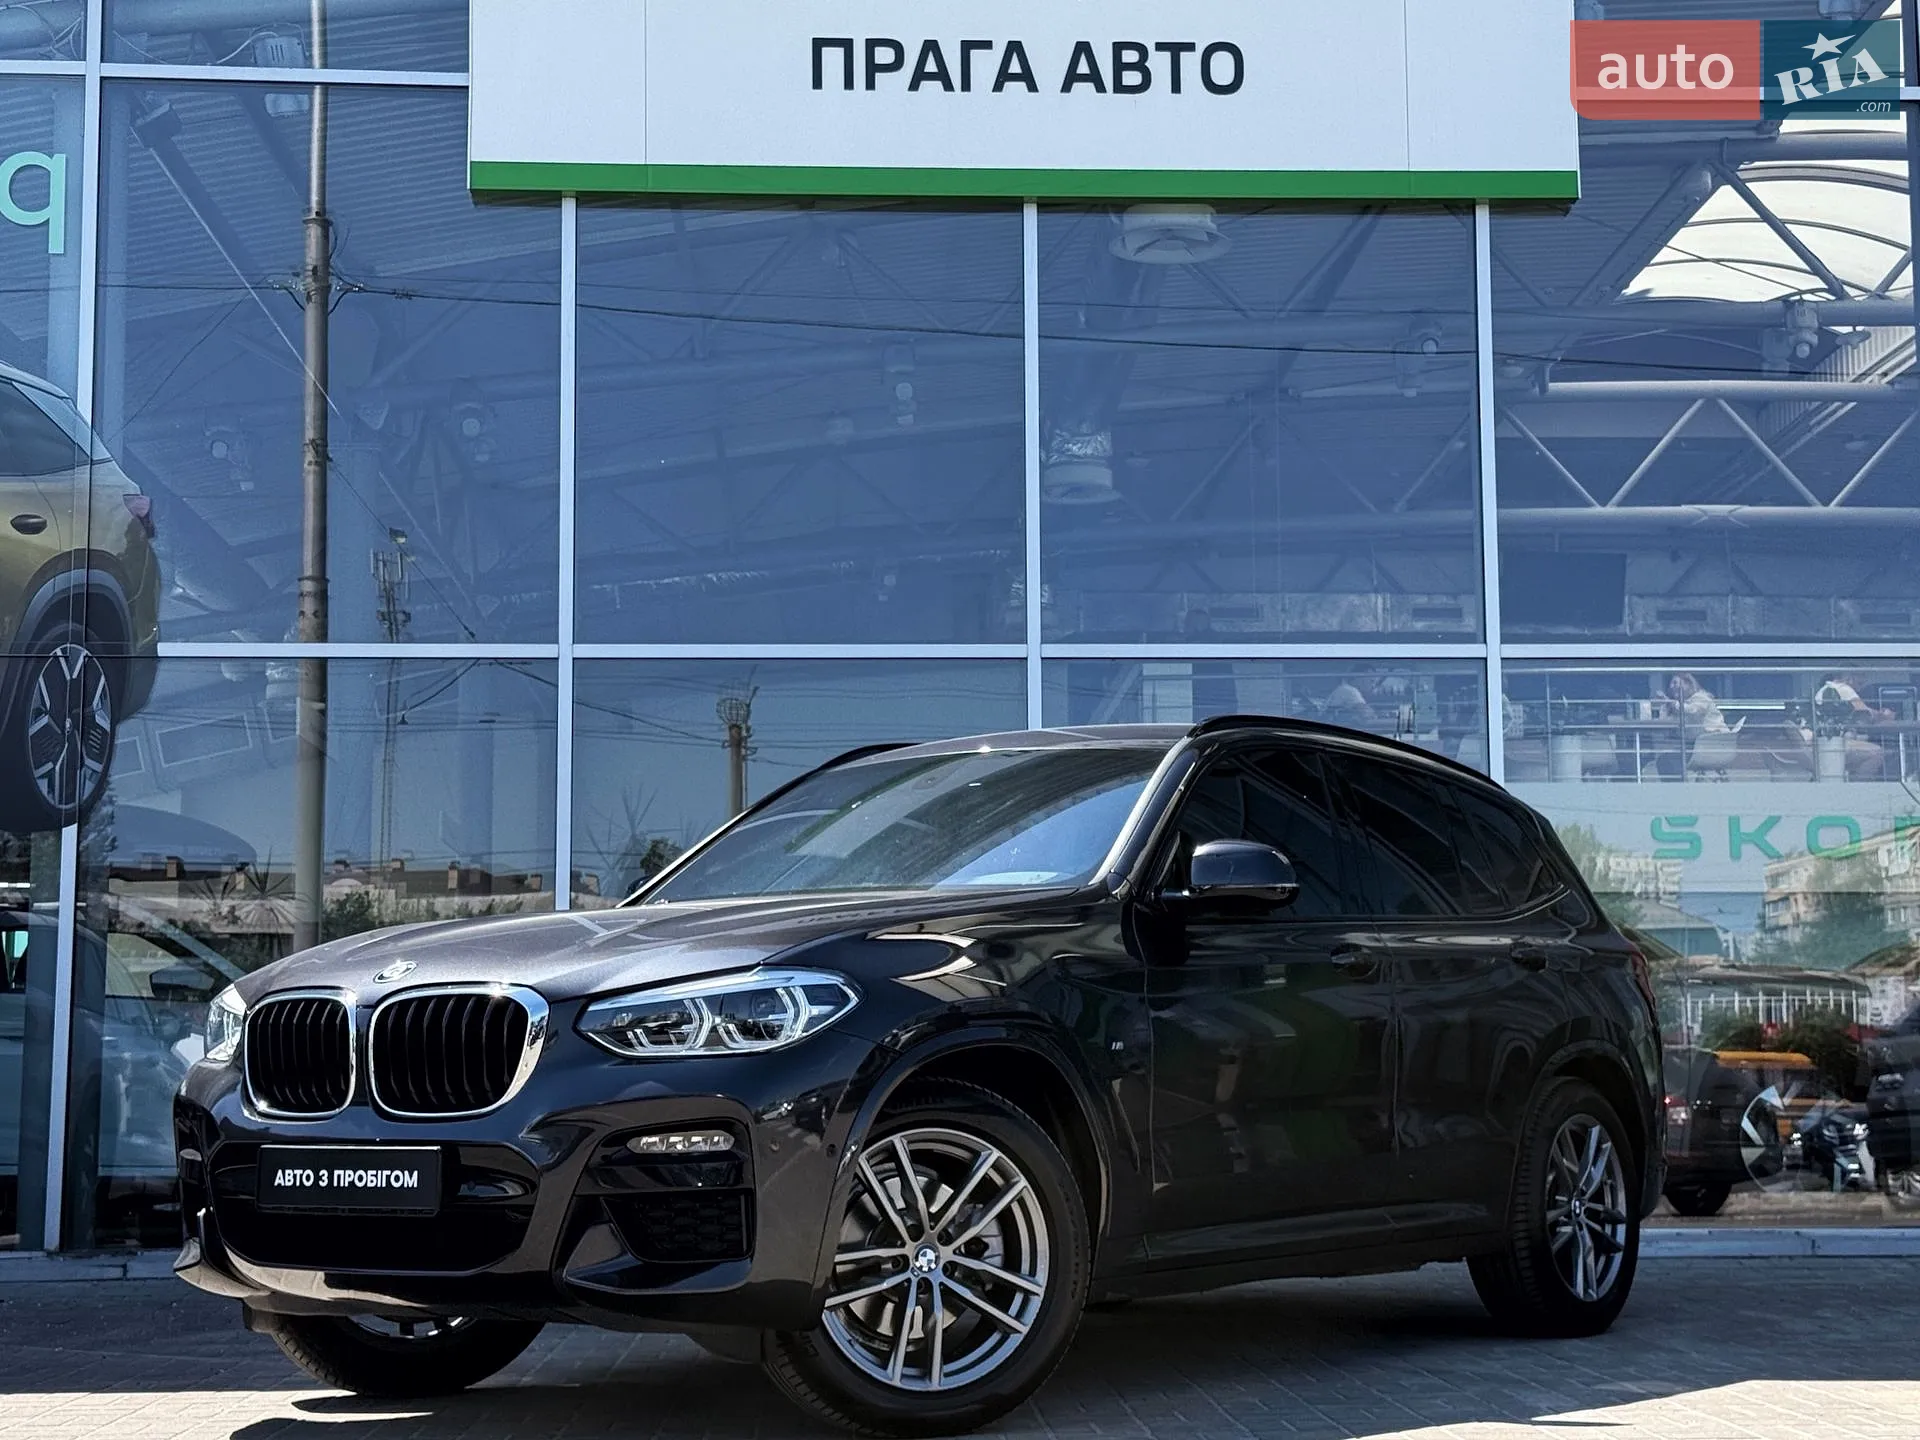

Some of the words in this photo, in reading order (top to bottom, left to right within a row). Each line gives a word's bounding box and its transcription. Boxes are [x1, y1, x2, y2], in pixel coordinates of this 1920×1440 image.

[811, 37, 1040, 94] ПРАГА
[1059, 40, 1245, 96] АВТО
[273, 1168, 315, 1187] АВТО
[333, 1169, 418, 1188] ПРОБІГОМ
